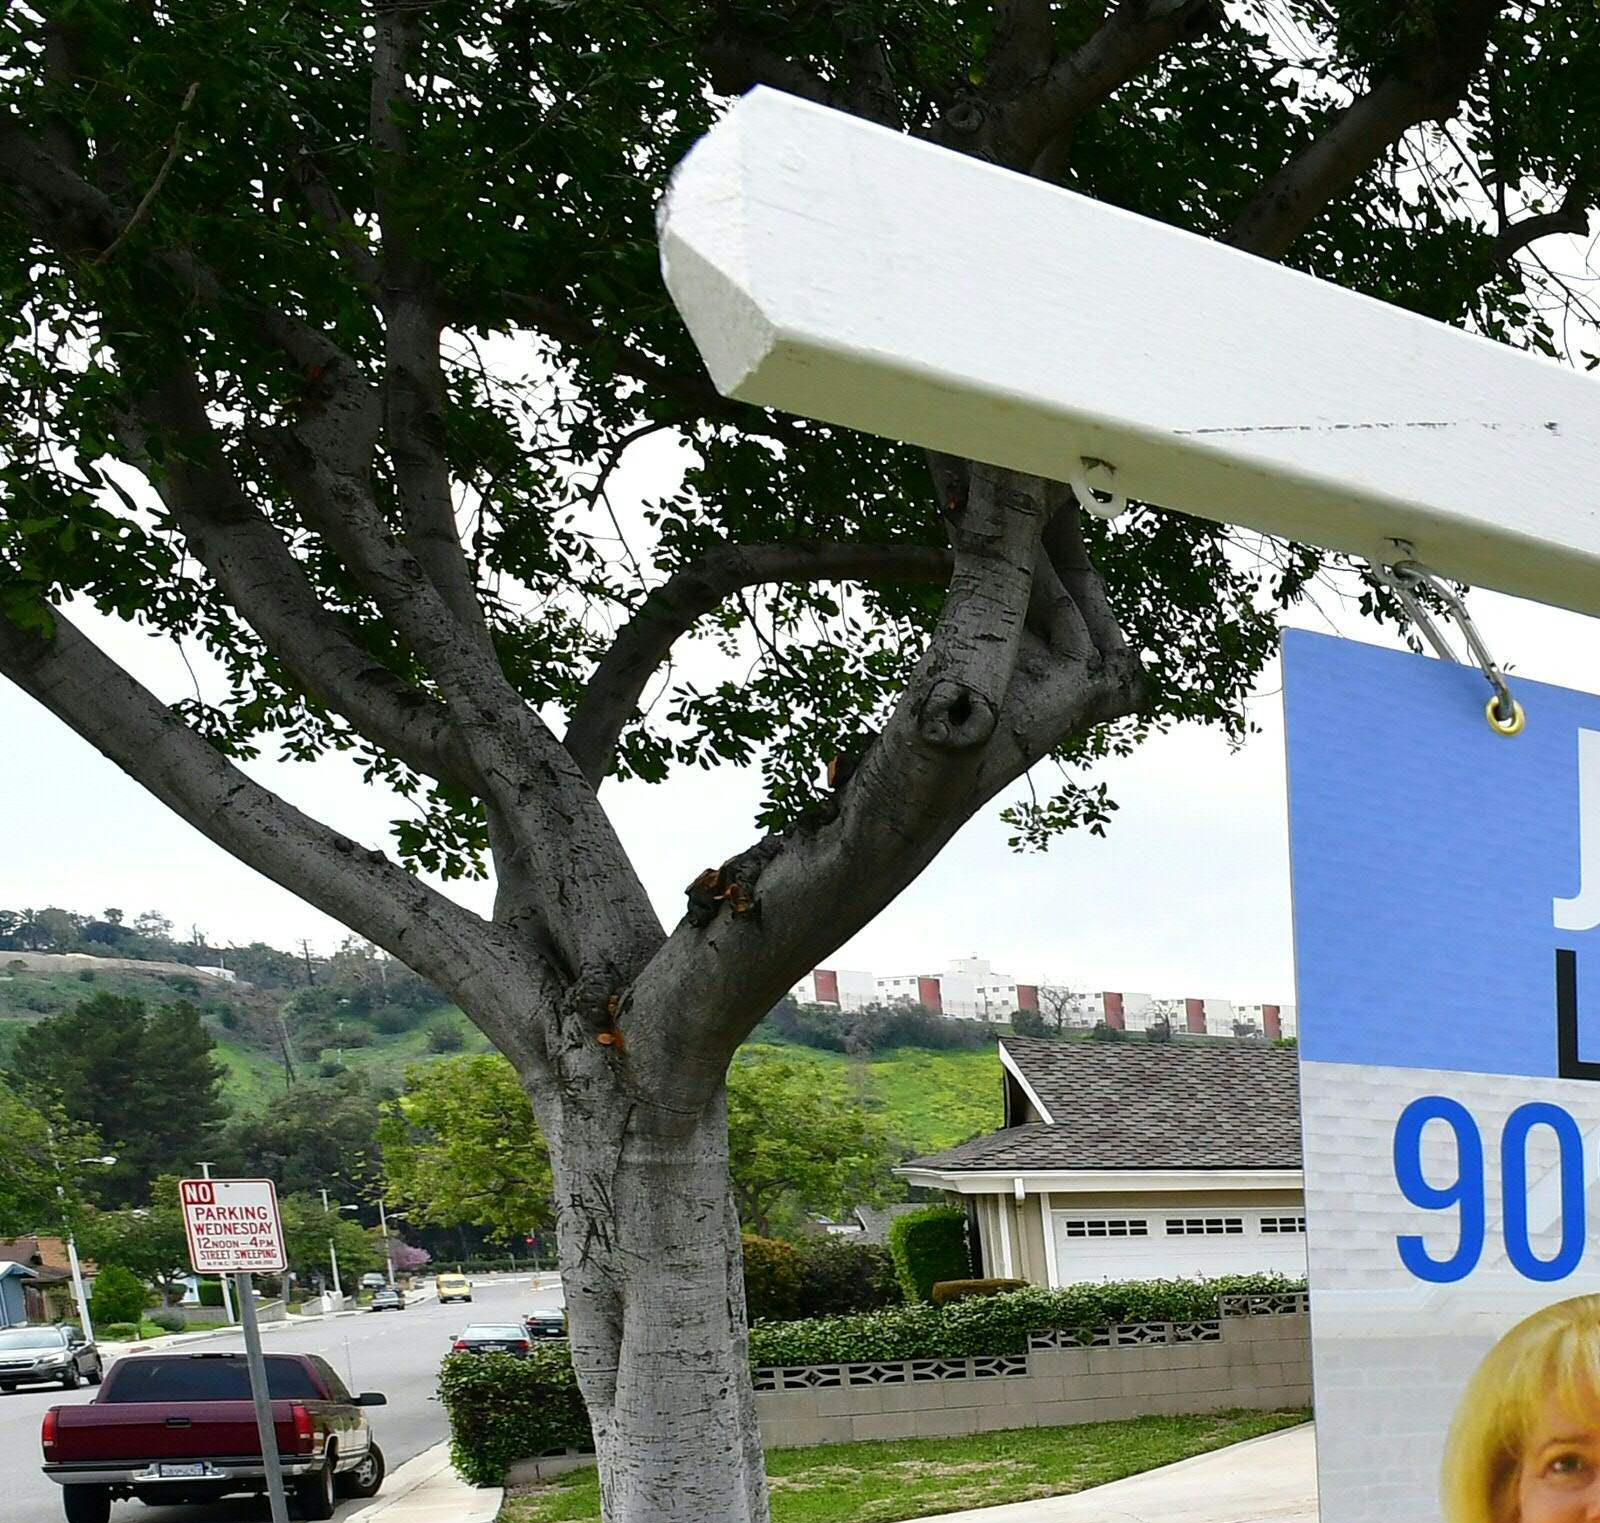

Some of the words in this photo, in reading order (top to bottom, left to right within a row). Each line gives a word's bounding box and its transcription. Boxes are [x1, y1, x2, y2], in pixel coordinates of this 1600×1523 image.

[184, 1183, 211, 1202] NO
[195, 1206, 267, 1220] PARKING
[193, 1222, 272, 1235] WEDNESDAY
[200, 1249, 230, 1260] STREET
[234, 1248, 277, 1259] SWEEPING
